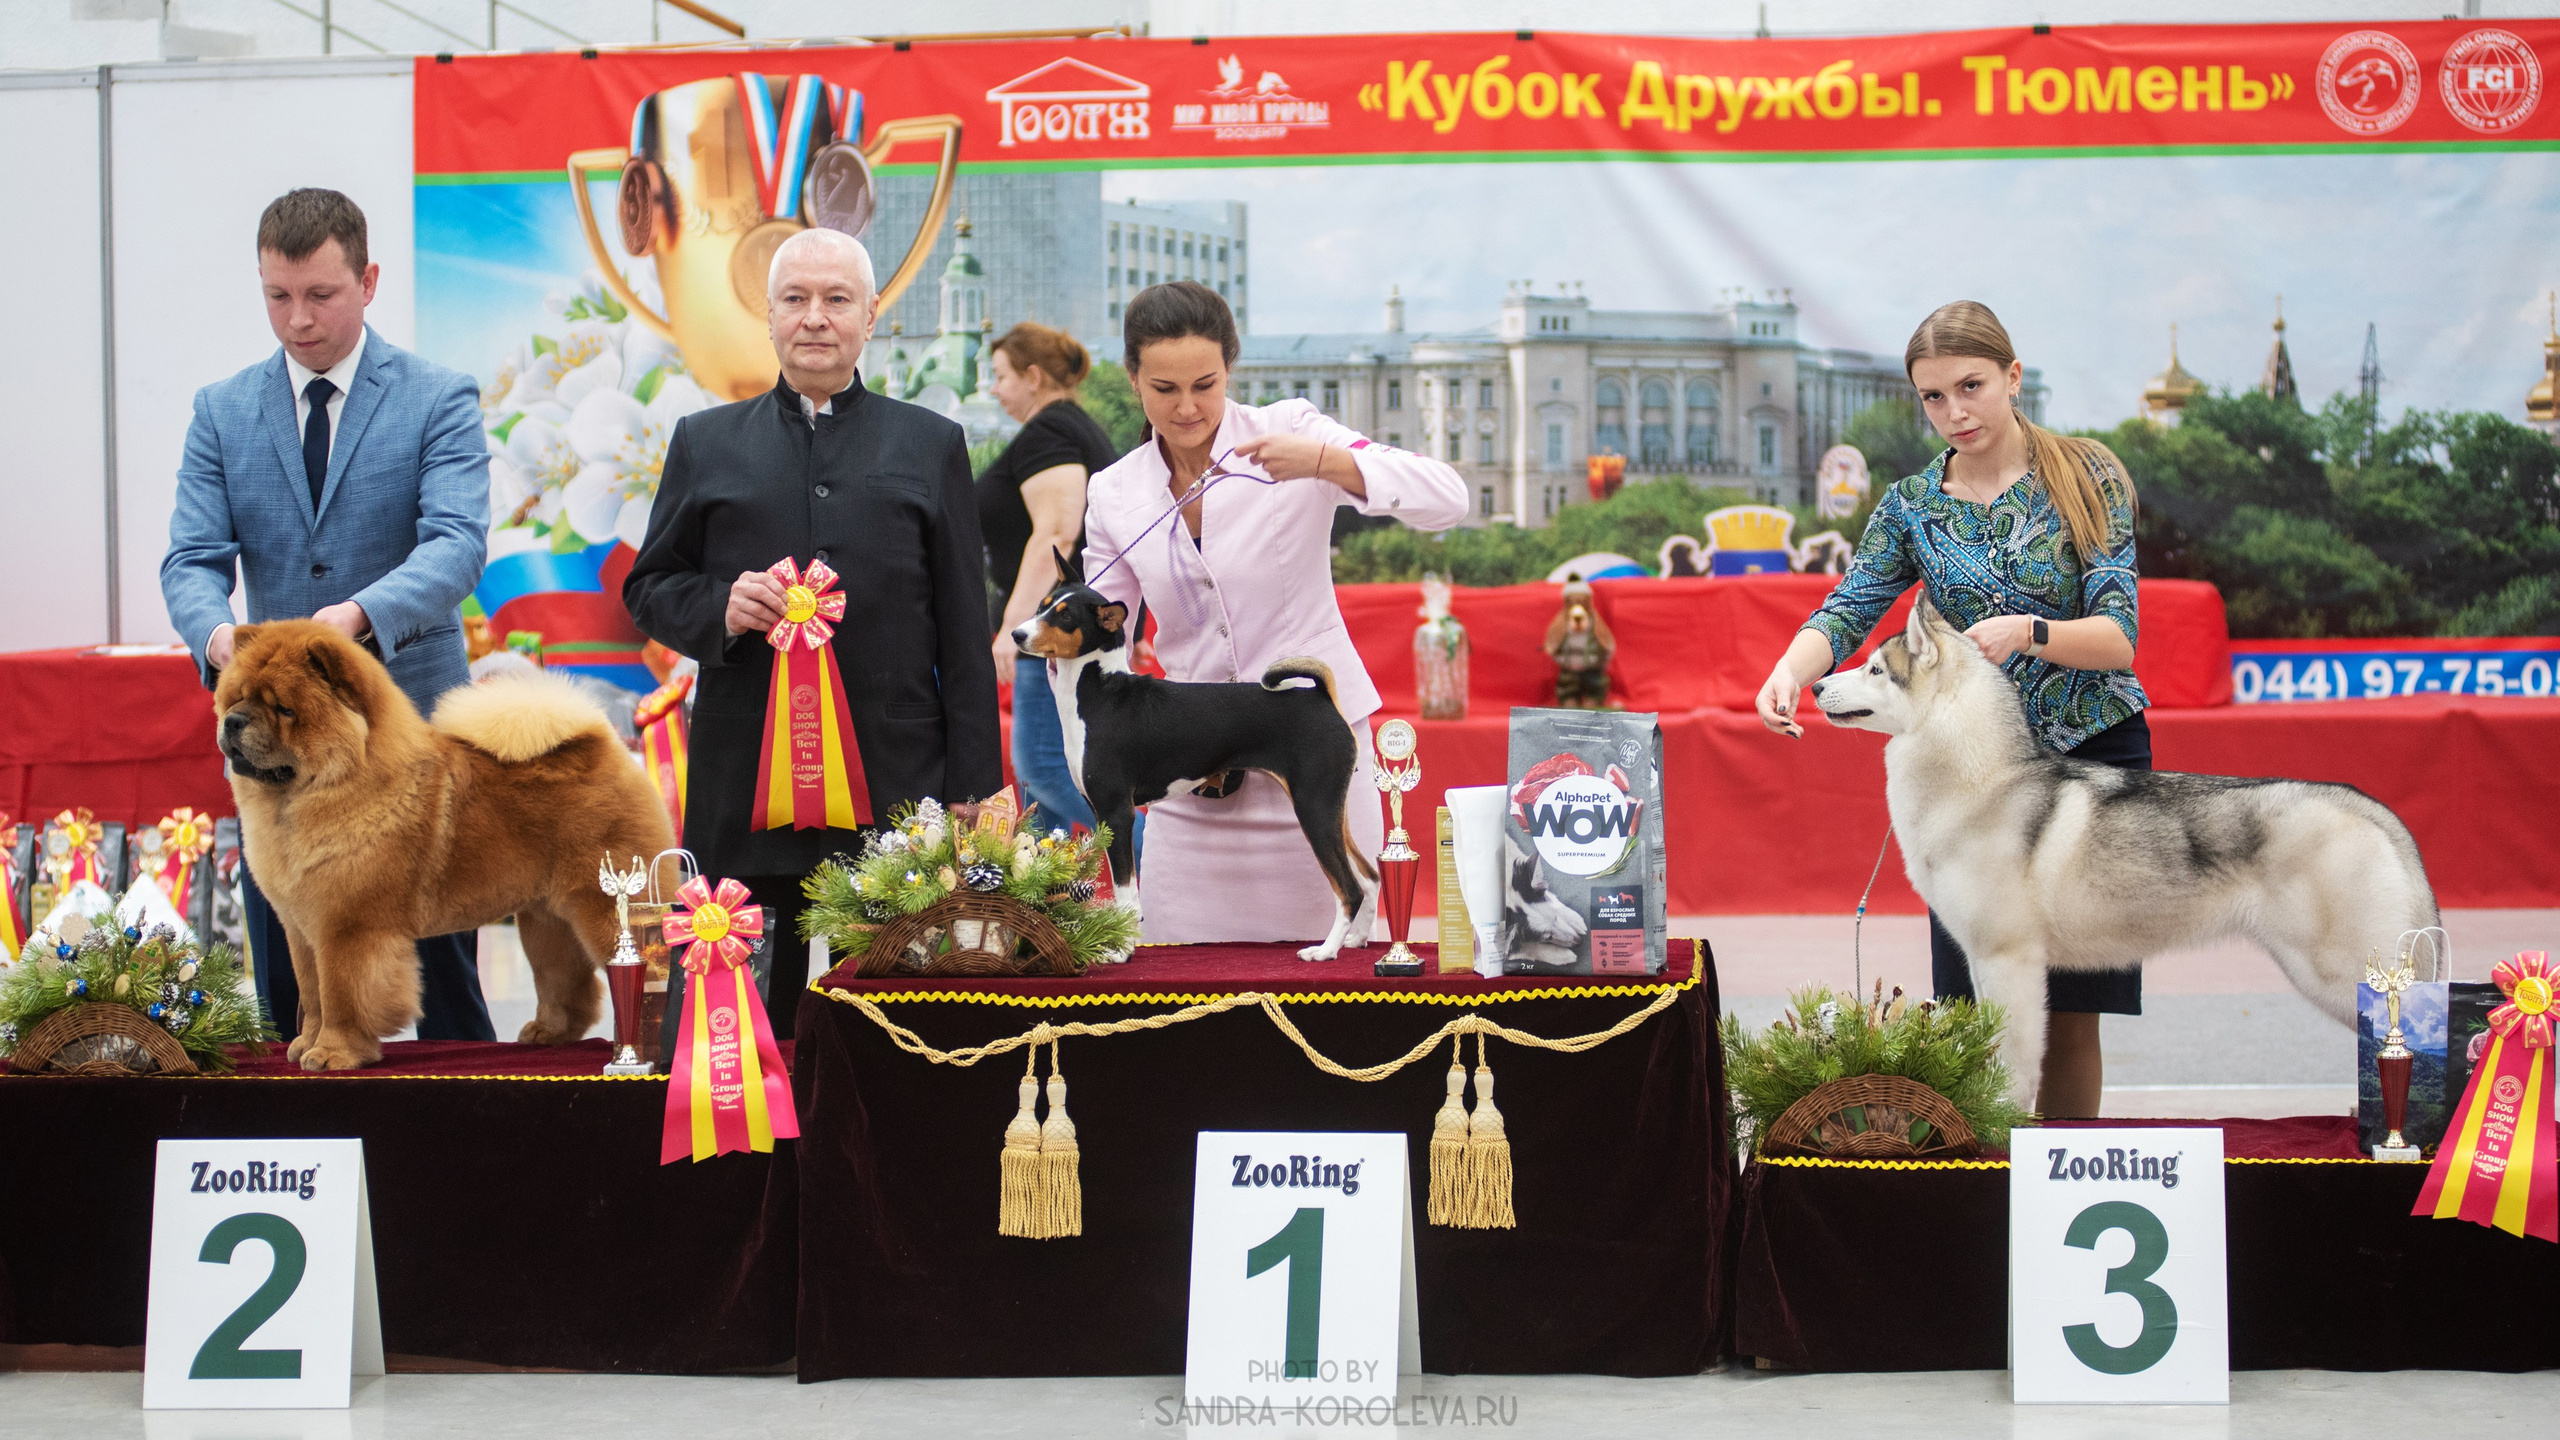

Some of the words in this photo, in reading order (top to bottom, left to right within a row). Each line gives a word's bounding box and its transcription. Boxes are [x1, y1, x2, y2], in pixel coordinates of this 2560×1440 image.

[2467, 67, 2514, 90] FCI
[1358, 55, 1606, 133] «Кубок
[1618, 60, 1942, 133] Дружбы.
[1962, 55, 2296, 116] Тюмень»
[1174, 104, 1205, 123] МИР
[1263, 101, 1329, 123] ПРИРОДЫ
[1215, 126, 1287, 140] ЗООЦЕНТР
[2233, 659, 2348, 703] 044)
[2362, 658, 2560, 699] 97-75-0
[796, 712, 815, 720] DOG
[792, 722, 819, 730] SHOW
[797, 740, 816, 748] Best
[802, 751, 812, 760] In
[792, 763, 823, 774] Group
[1555, 791, 1611, 804] AlphaPet
[1522, 803, 1637, 845] WOW
[714, 1033, 734, 1043] DOG
[711, 1042, 738, 1053] SHOW
[715, 1060, 735, 1070] Best
[720, 1072, 731, 1080] In
[710, 1083, 743, 1093] Group
[2493, 1102, 2514, 1113] DOG
[2487, 1110, 2516, 1124] SHOW
[2486, 1129, 2507, 1141] Best
[2488, 1141, 2499, 1151] In
[2474, 1150, 2507, 1167] Group
[1246, 1207, 1325, 1378] 1
[2061, 1200, 2179, 1376] 3
[188, 1211, 307, 1380] 2
